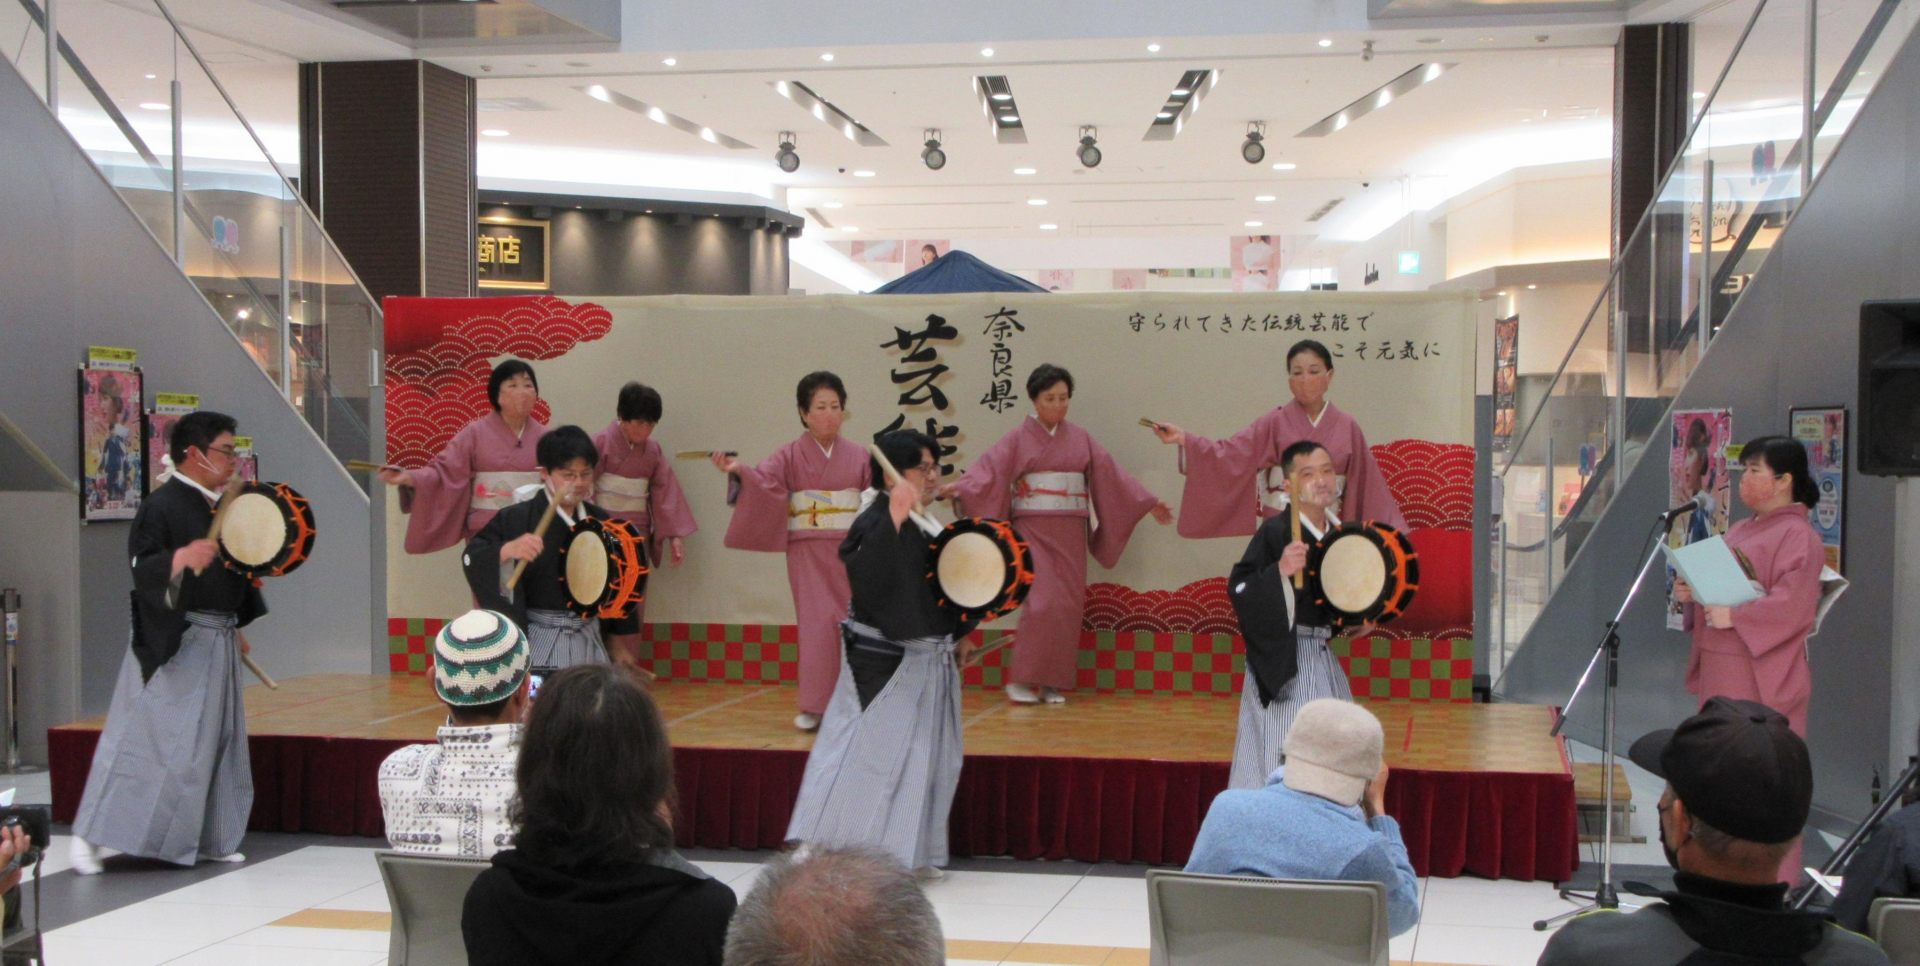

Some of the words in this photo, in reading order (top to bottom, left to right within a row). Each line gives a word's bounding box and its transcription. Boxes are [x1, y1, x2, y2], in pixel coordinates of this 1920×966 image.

[1129, 312, 1375, 332] 守られてきた伝統芸能で
[979, 306, 1025, 414] 奈良県
[1332, 341, 1441, 361] こそ元気に
